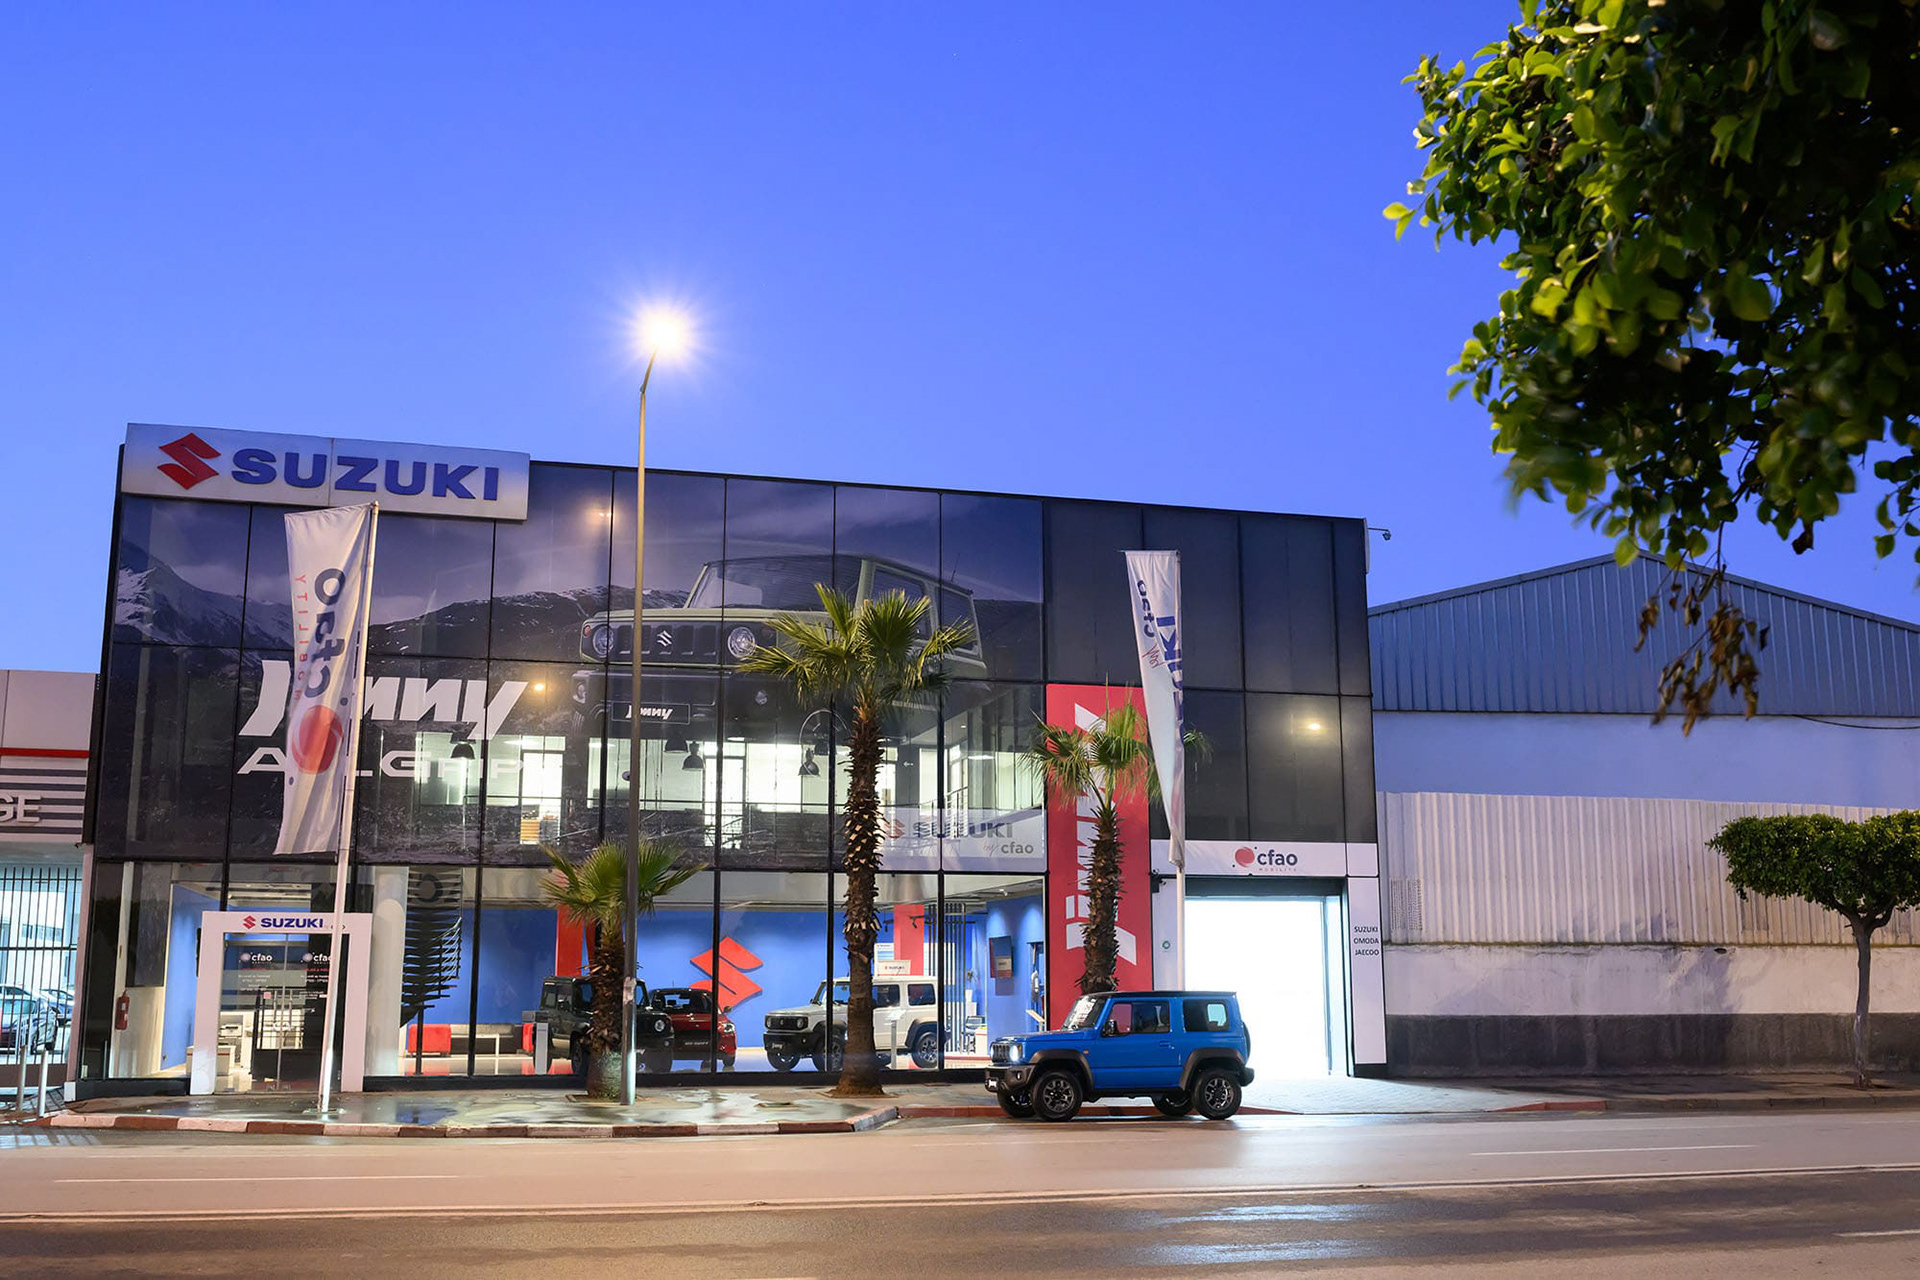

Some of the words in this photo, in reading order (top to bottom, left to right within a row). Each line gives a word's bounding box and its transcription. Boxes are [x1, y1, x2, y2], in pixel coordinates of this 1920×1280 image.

[231, 448, 499, 501] SUZUKI
[239, 660, 528, 740] Jny
[625, 705, 674, 720] Jmny
[1001, 841, 1034, 855] cfao
[1257, 849, 1298, 866] cfao
[260, 917, 323, 929] SUZUKI
[1353, 937, 1379, 945] OMODA
[251, 953, 273, 962] cfao
